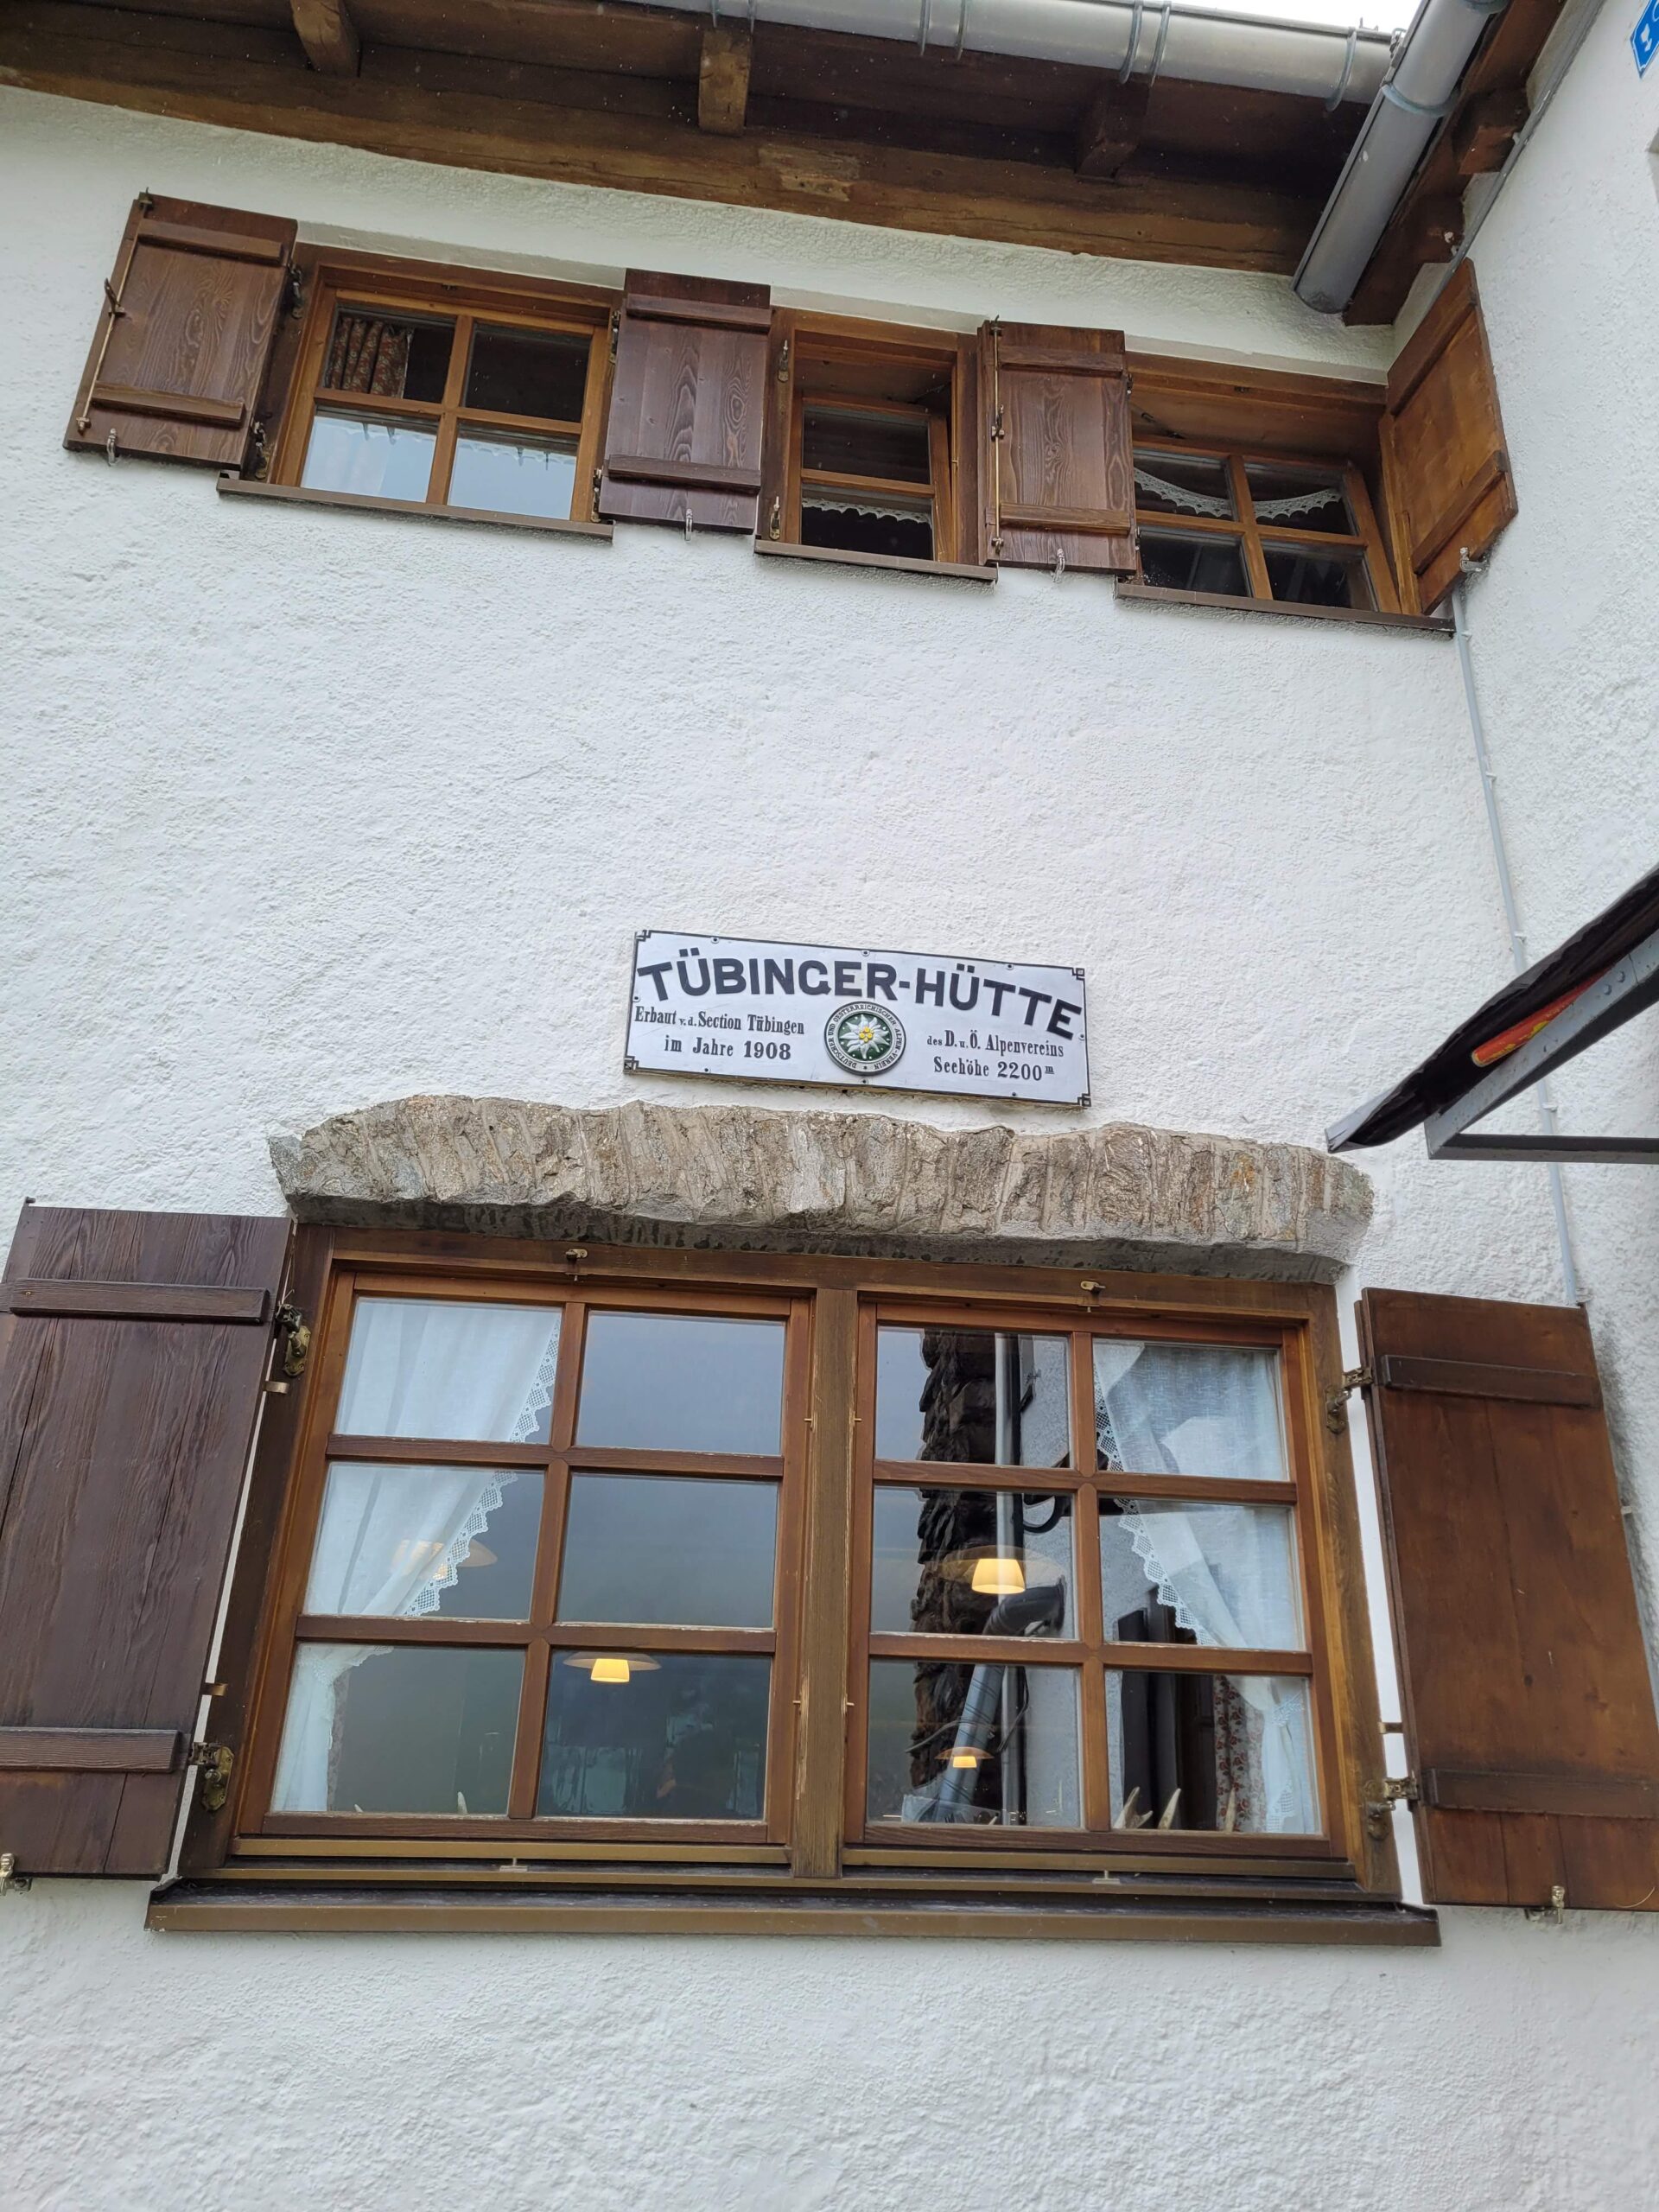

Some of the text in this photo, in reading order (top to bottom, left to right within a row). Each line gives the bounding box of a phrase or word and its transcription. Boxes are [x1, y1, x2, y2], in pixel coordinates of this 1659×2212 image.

[638, 947, 1082, 1040] TÜBINGER-HÜTTE
[634, 1006, 677, 1025] Erbaut
[698, 1011, 741, 1030] Section
[747, 1014, 804, 1035] Tübingen
[664, 1035, 791, 1060] im Jahre 1908
[927, 1036, 943, 1046] des
[985, 1034, 1064, 1057] Alpenvereins
[933, 1056, 989, 1077] Seehöhe
